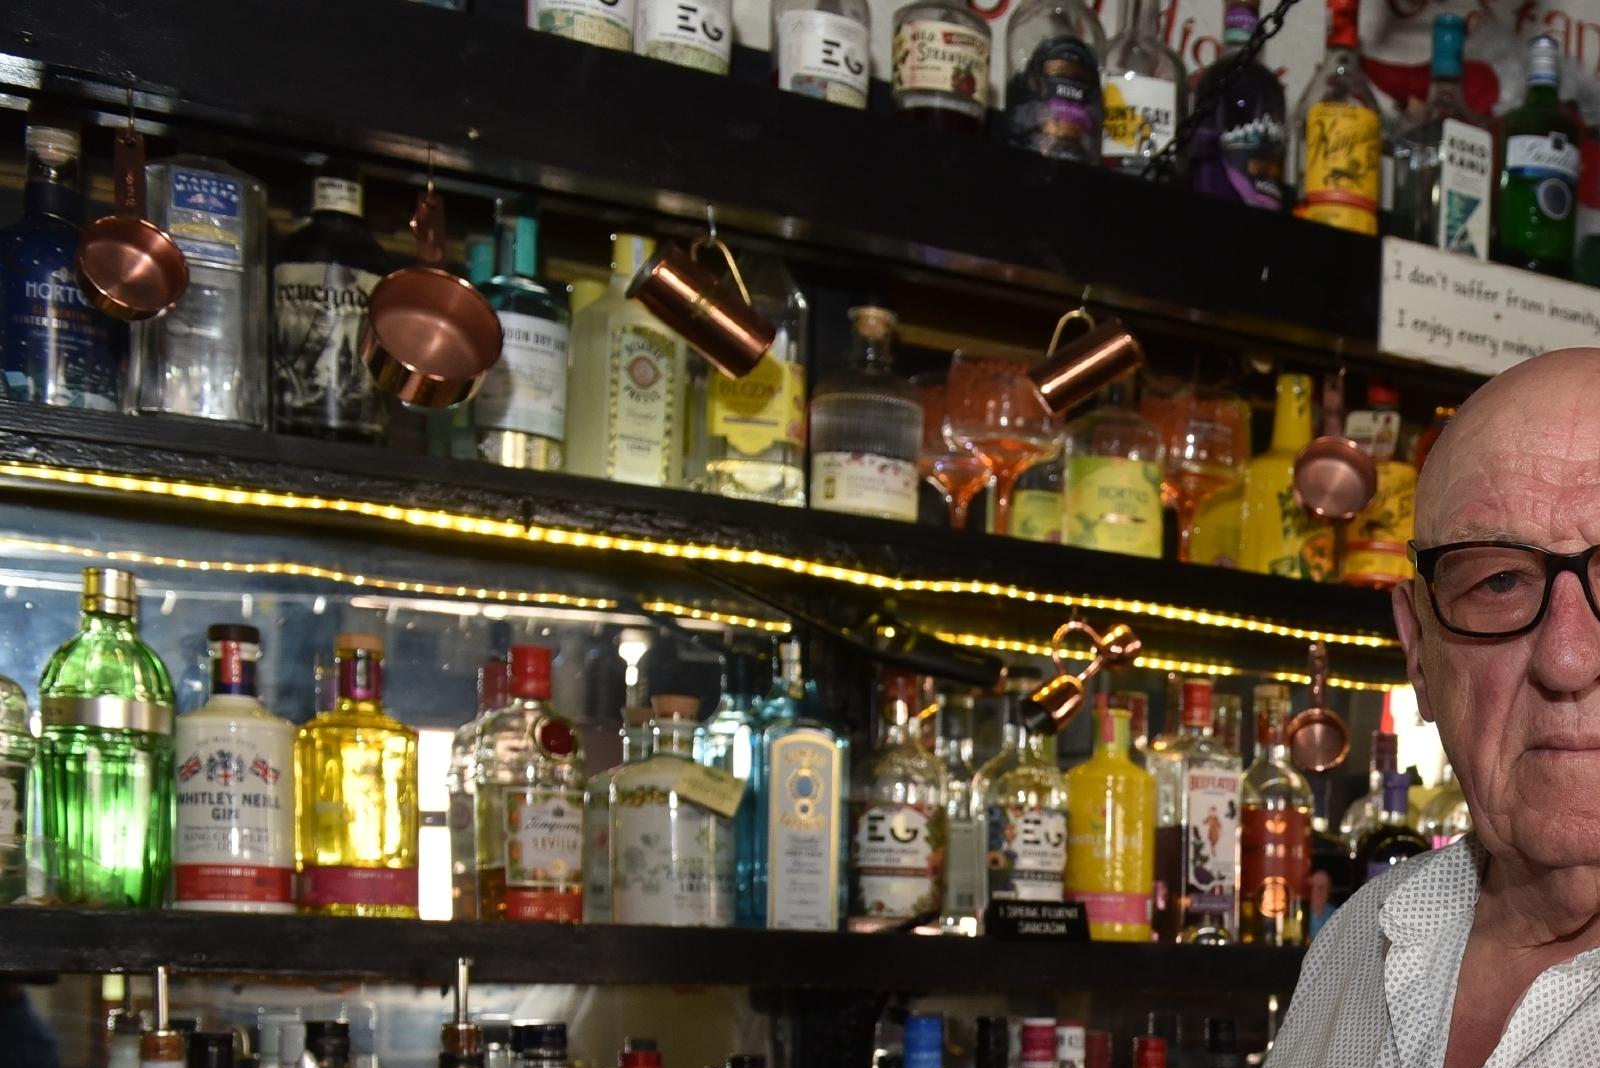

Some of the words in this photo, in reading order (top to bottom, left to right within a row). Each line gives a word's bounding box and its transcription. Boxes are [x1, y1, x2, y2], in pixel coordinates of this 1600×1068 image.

[1395, 260, 1402, 279] I
[1408, 264, 1448, 291] don't
[1453, 278, 1499, 301] suffer
[1506, 286, 1545, 314] from
[1397, 308, 1406, 328] I
[1412, 316, 1453, 347] enjoy
[1457, 330, 1499, 358] every
[176, 791, 234, 807] WHITLEY
[210, 807, 241, 822] GIN
[1017, 920, 1067, 936] SARCASM
